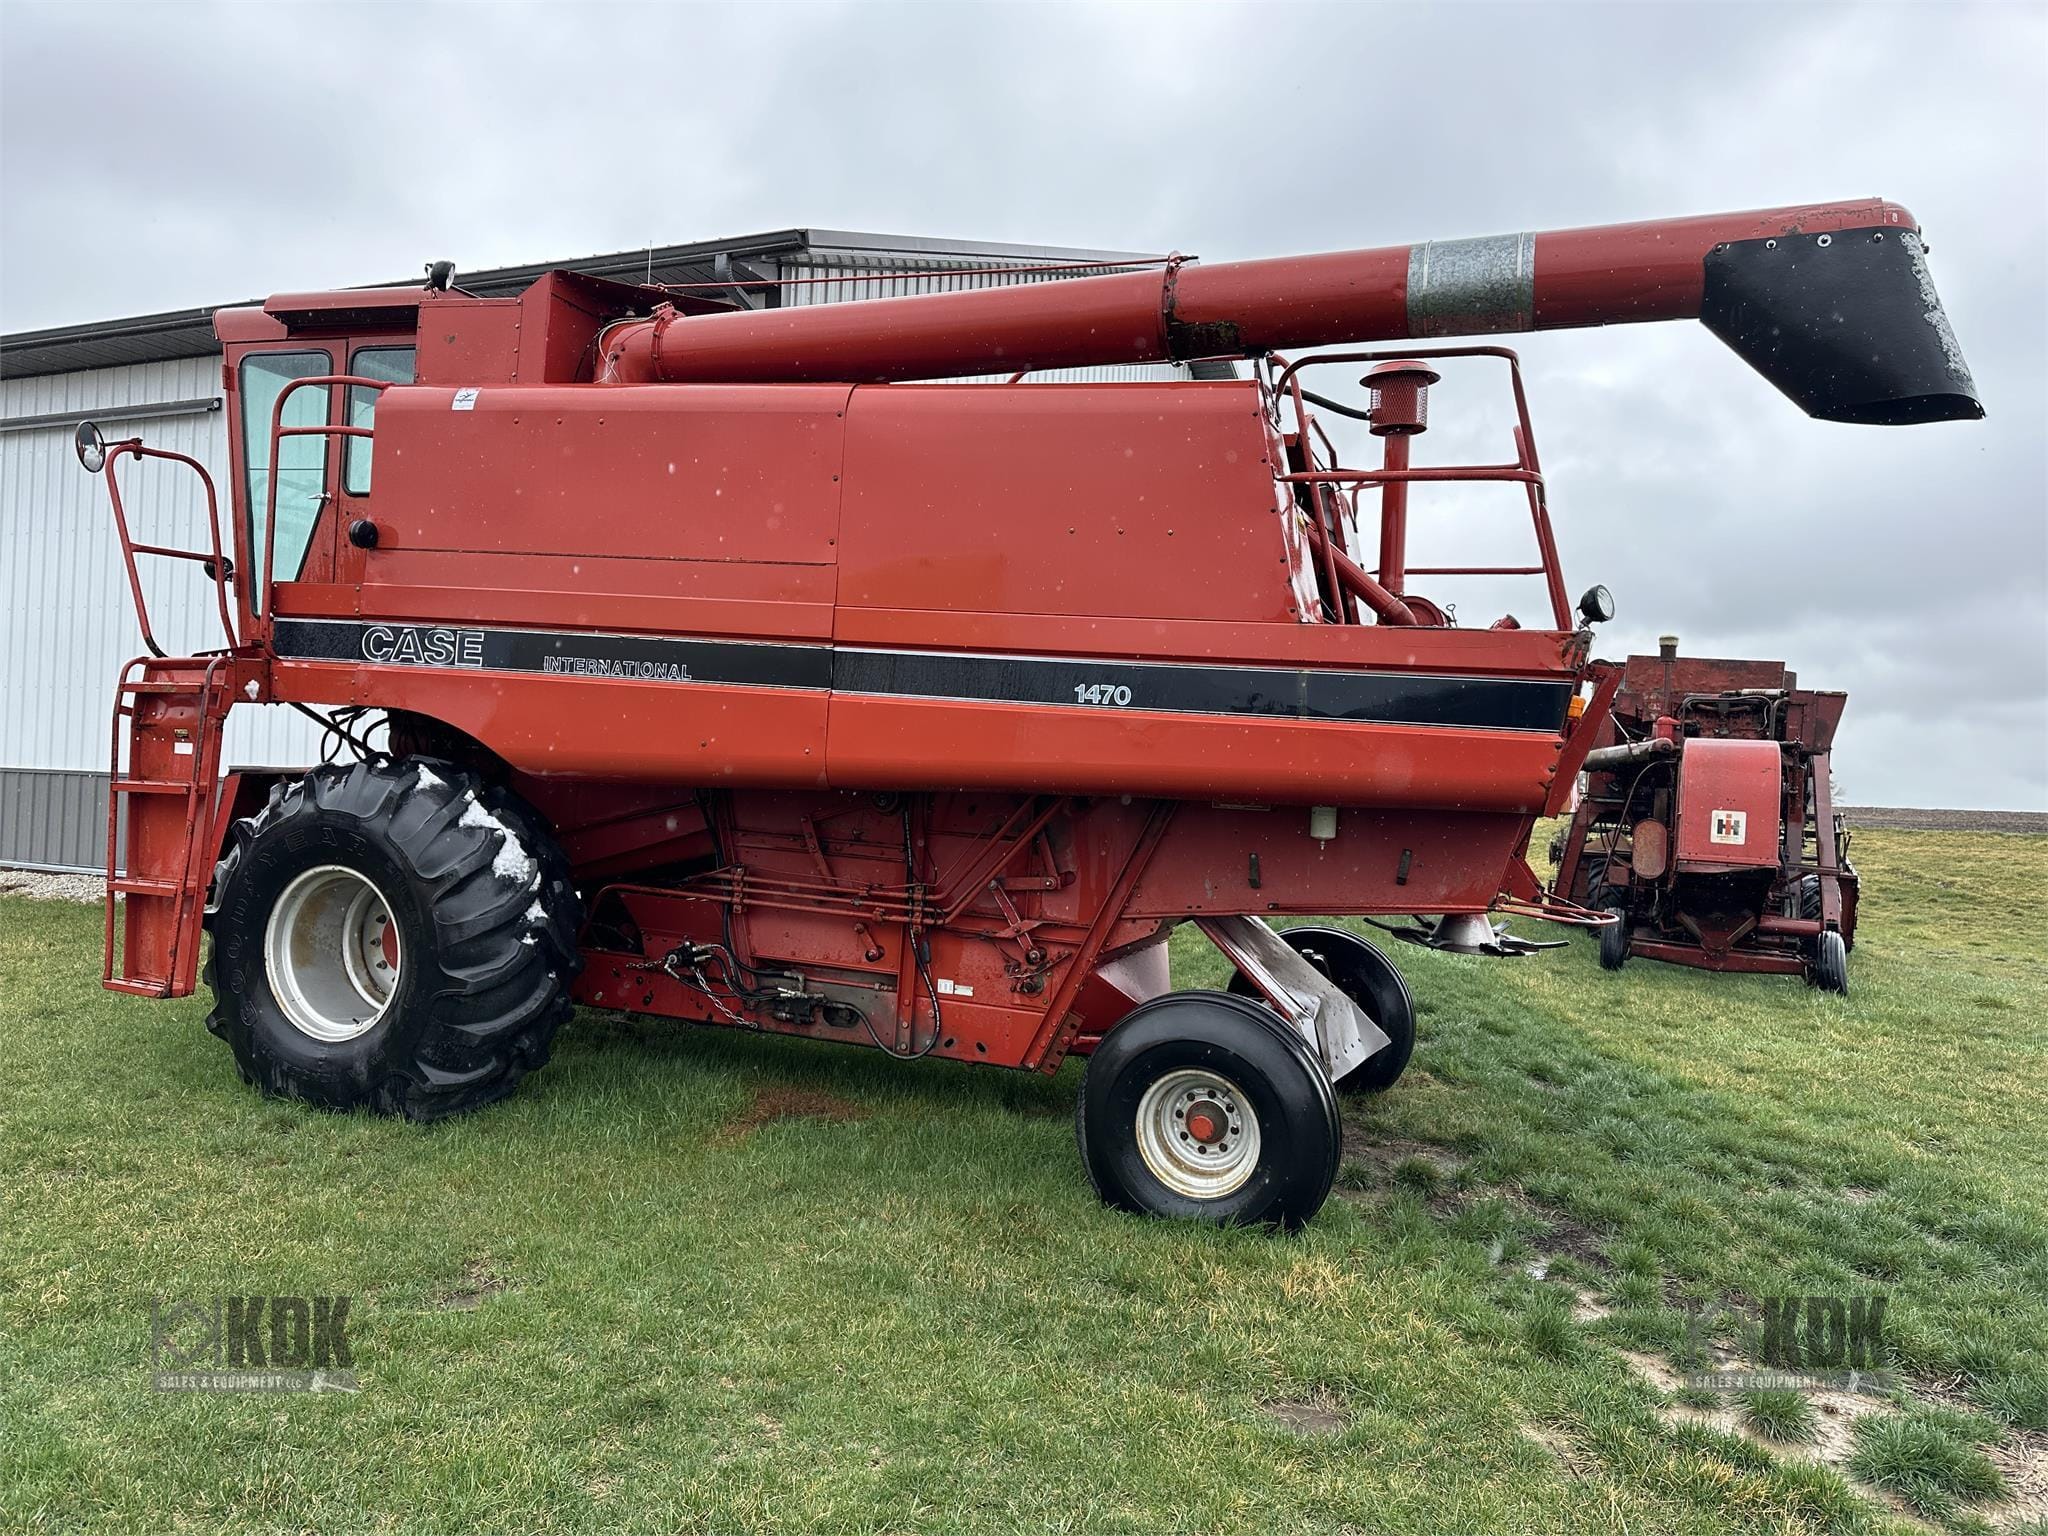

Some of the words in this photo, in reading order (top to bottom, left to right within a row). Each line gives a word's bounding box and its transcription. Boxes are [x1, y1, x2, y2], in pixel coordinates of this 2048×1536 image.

[361, 626, 485, 667] CASE
[543, 655, 692, 681] INTERNATIONAL
[1074, 683, 1132, 706] 1470
